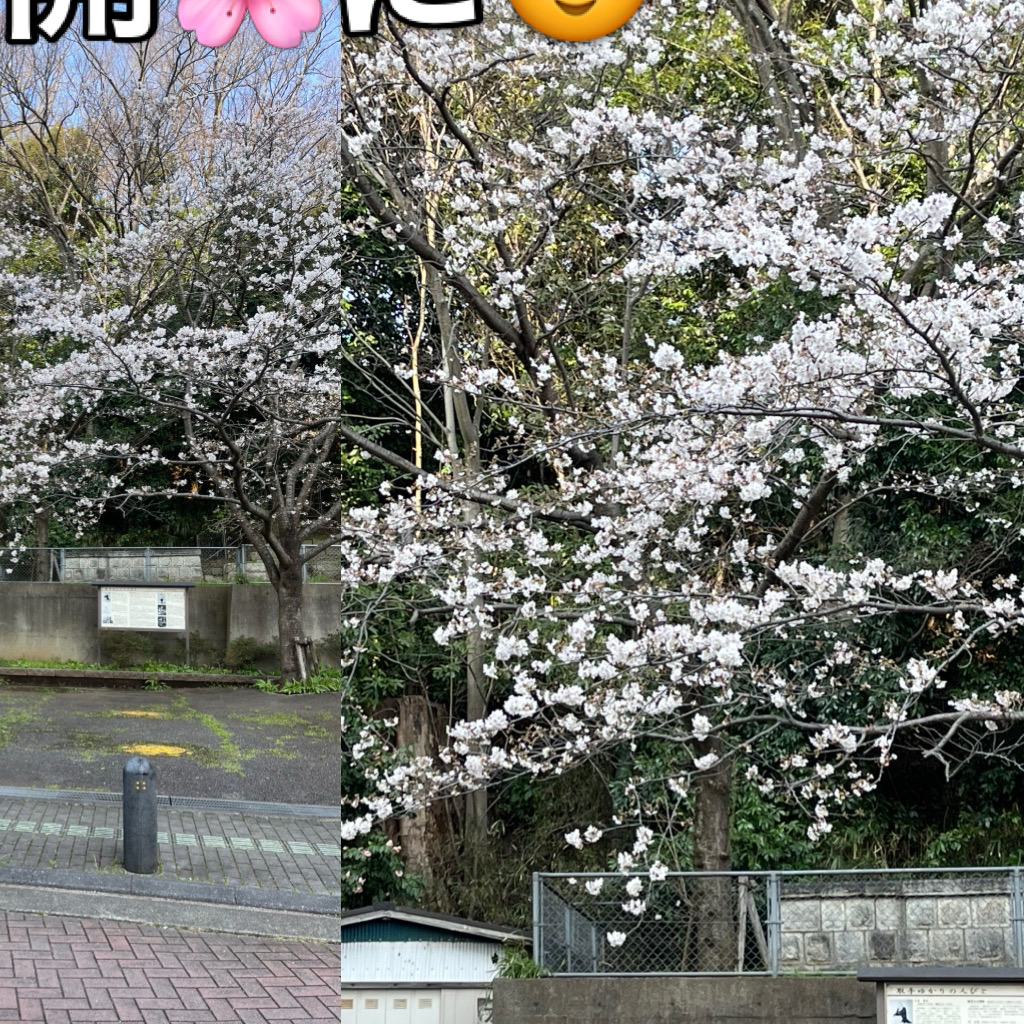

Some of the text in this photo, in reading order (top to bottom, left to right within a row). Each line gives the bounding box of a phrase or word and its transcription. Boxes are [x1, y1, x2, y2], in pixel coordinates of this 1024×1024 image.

[896, 987, 988, 995] 取手ゆかりの人びと
